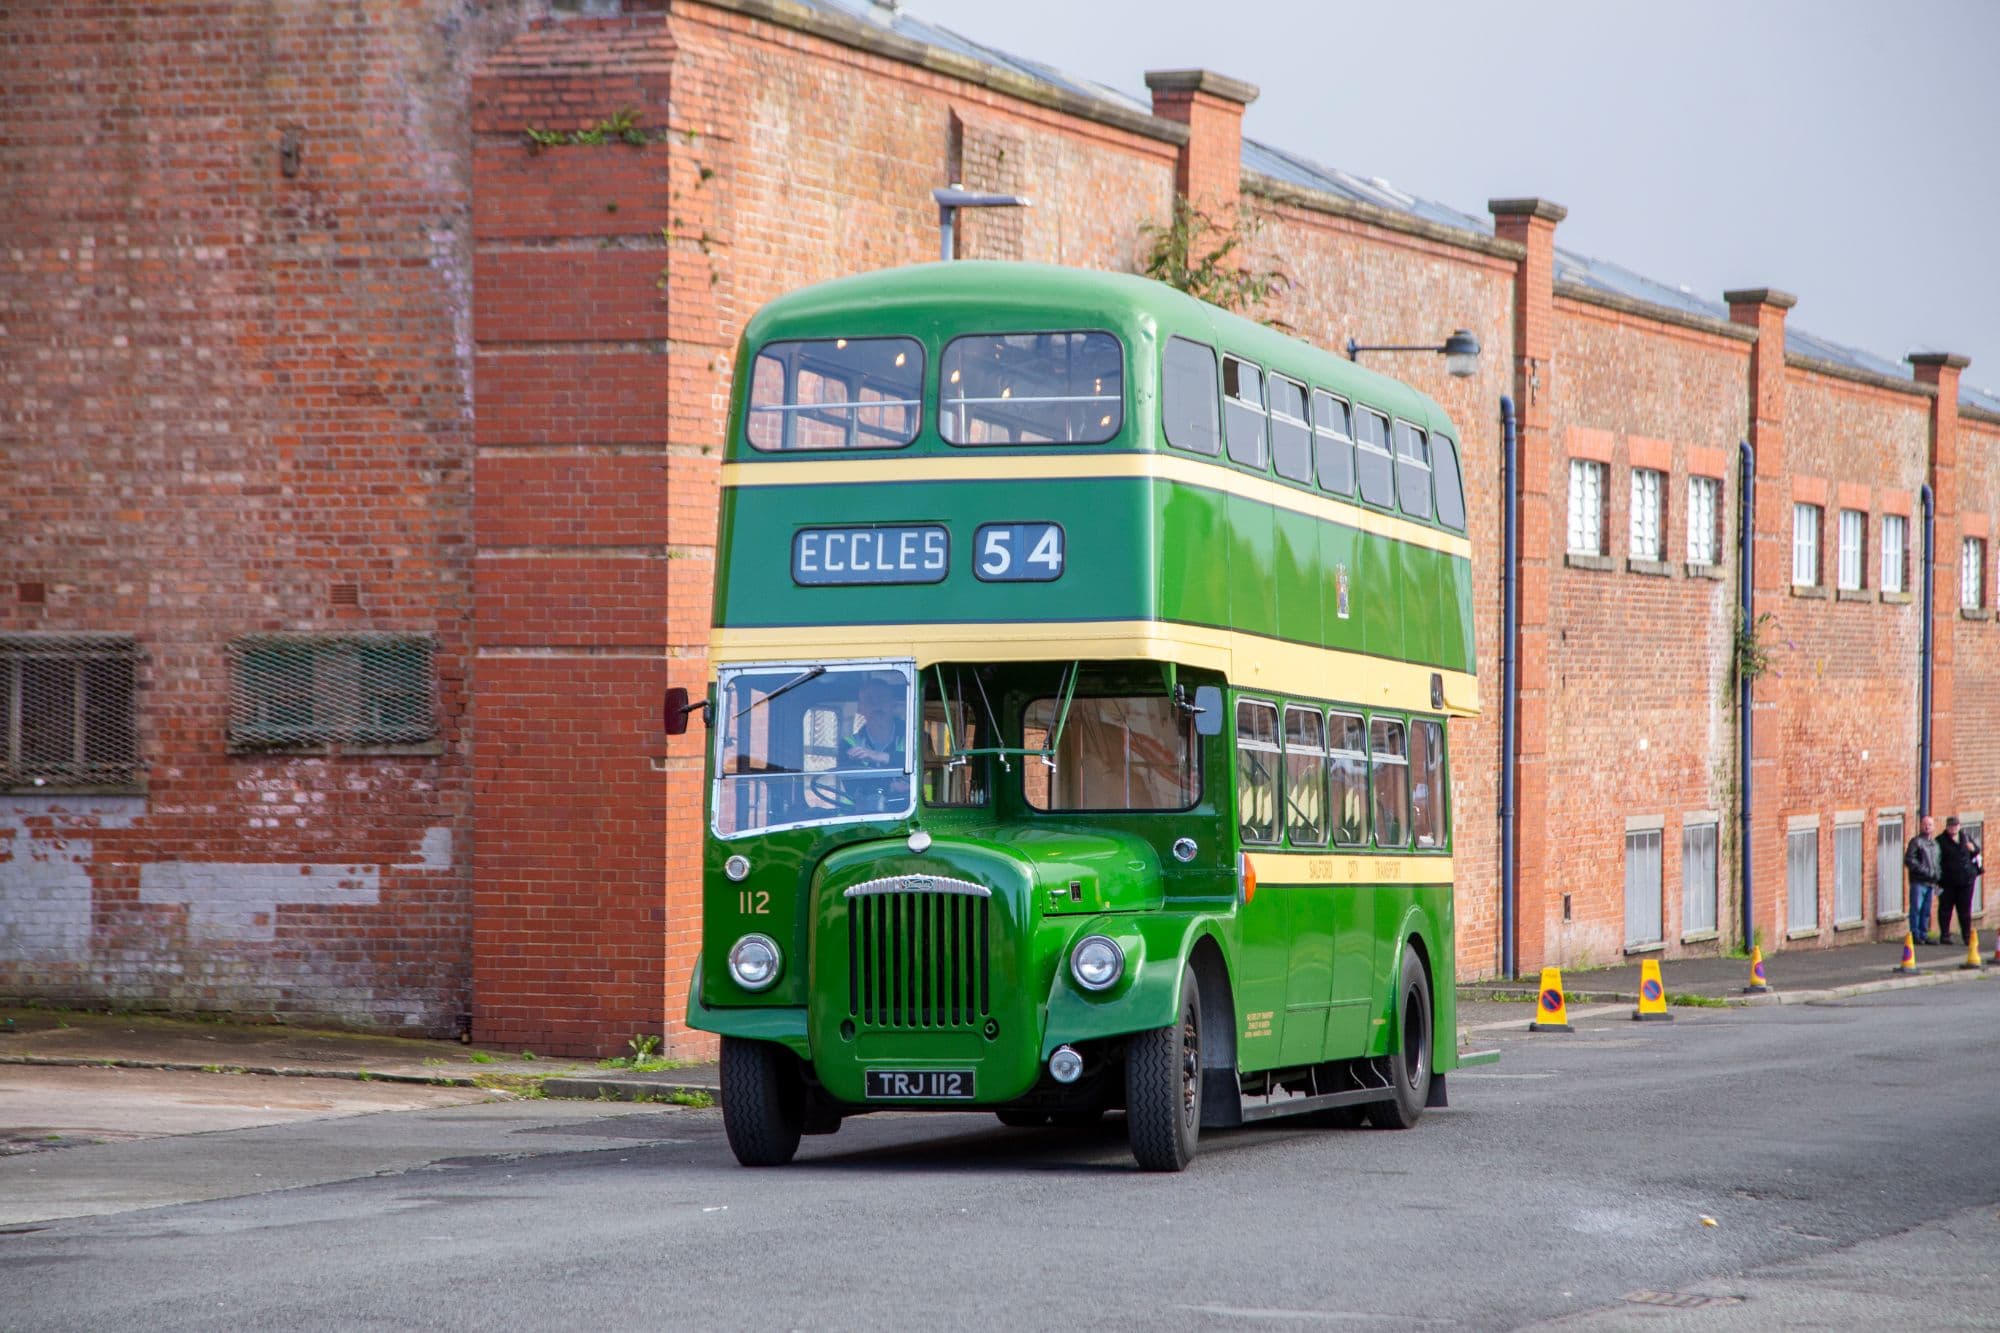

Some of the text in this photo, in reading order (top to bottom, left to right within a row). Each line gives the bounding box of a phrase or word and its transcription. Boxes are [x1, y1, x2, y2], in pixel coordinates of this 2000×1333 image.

[800, 531, 944, 571] ECCLES
[739, 891, 769, 914] 112
[879, 1073, 962, 1095] TRJ 112
